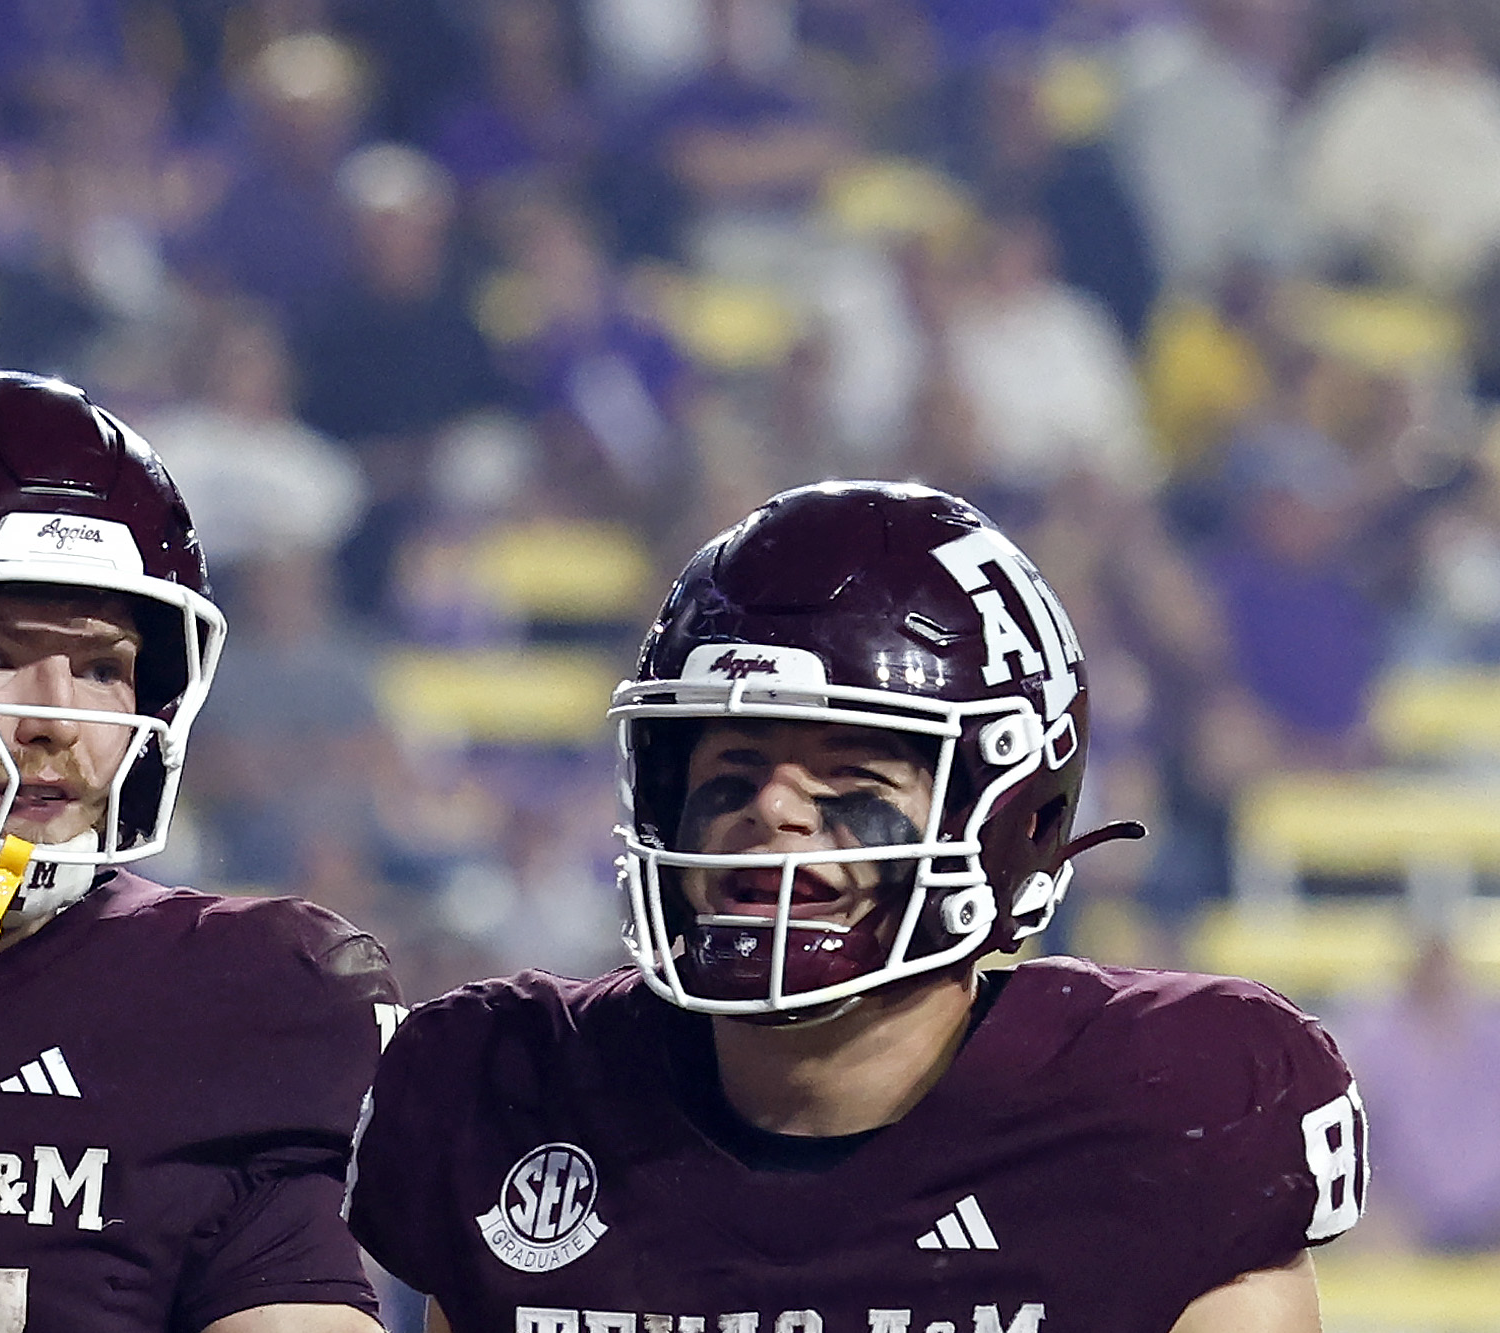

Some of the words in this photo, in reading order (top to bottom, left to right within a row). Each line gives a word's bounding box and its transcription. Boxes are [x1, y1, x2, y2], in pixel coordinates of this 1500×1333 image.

[37, 517, 104, 550] Aggies
[709, 649, 779, 680] Aggies
[509, 1151, 590, 1238] SEC
[491, 1229, 586, 1269] GRADUATE
